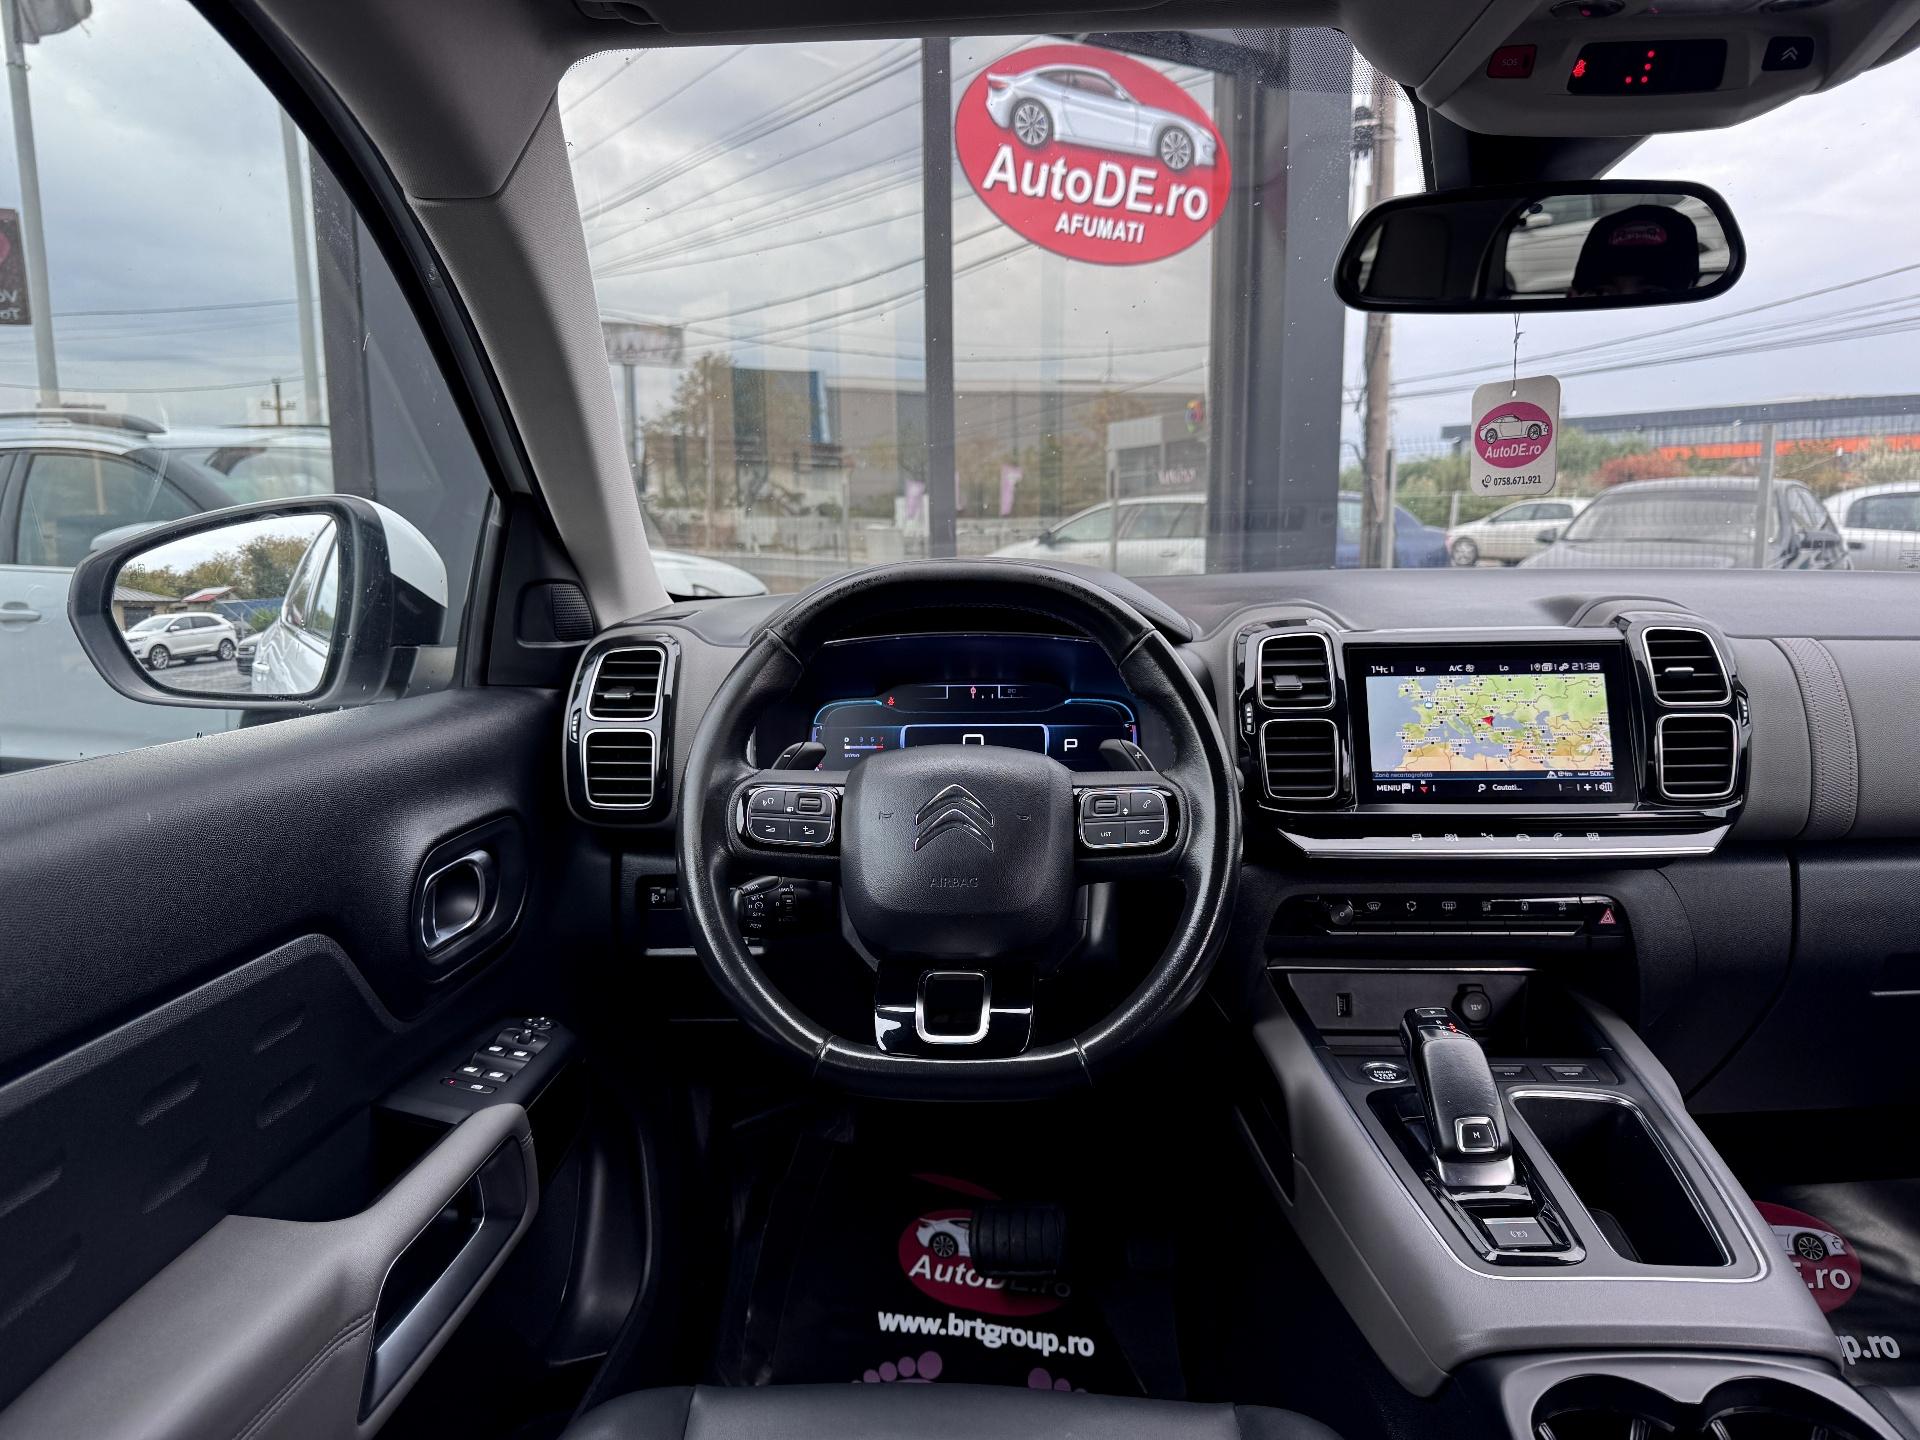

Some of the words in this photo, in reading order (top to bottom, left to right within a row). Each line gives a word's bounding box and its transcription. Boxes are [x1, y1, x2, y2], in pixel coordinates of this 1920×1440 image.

[982, 143, 1209, 221] AutoDE.ro
[1055, 213, 1144, 243] AFUMATI
[1484, 443, 1542, 459] AutoDE.ro
[1493, 474, 1542, 487] 0758.671.921
[1571, 662, 1601, 671] 21:38
[1063, 738, 1079, 752] P
[1376, 784, 1401, 792] MENIU
[929, 877, 979, 888] AIRBAG
[877, 1310, 1095, 1357] www.brtgroup.ro
